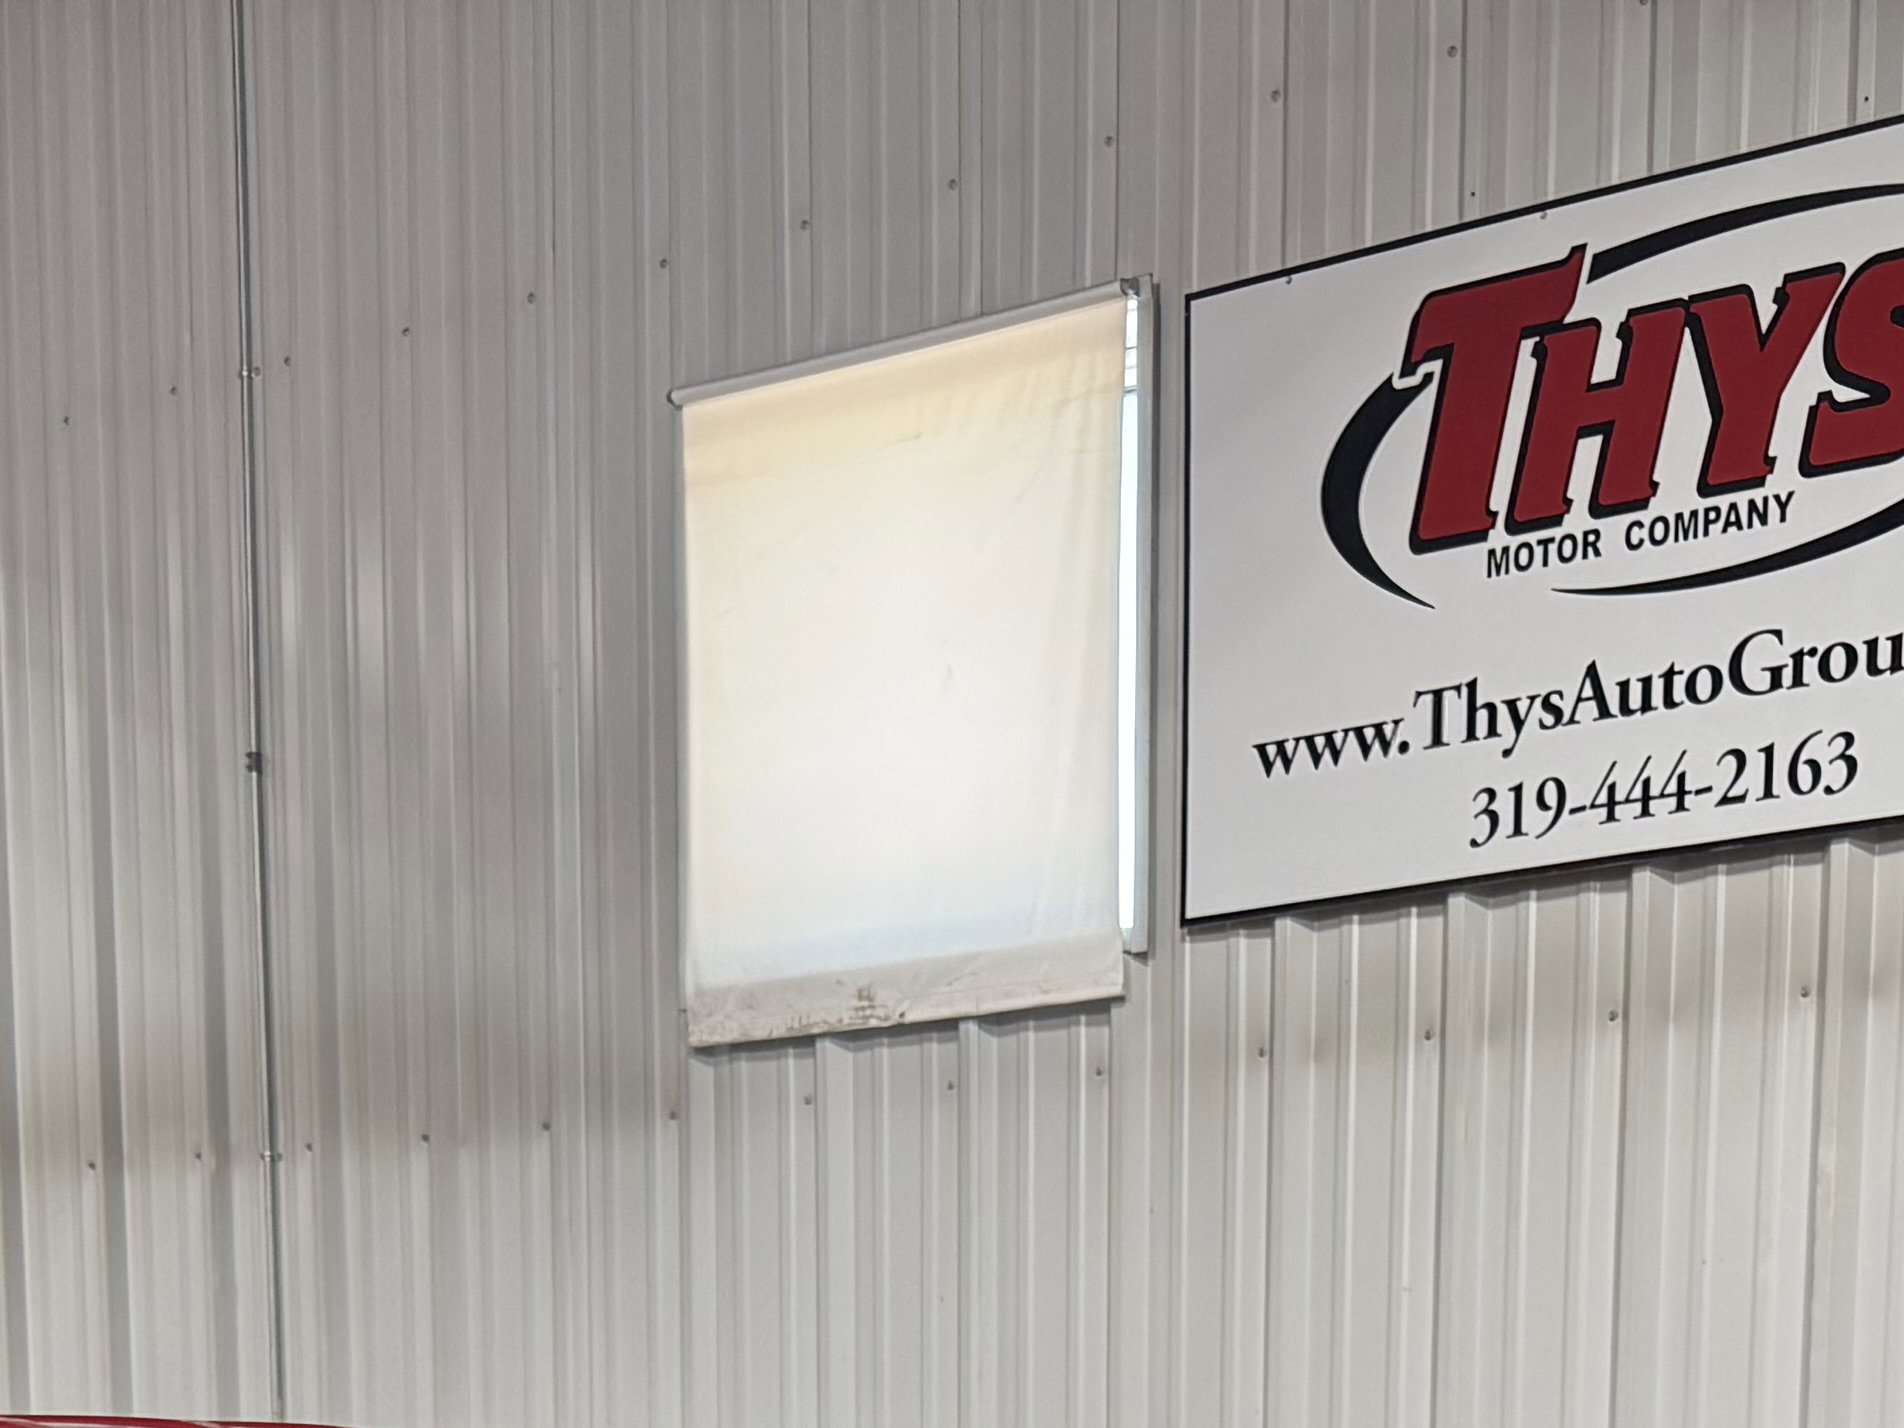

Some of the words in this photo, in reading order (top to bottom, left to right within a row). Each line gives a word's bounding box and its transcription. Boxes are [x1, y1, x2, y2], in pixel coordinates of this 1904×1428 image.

[1486, 527, 1603, 579] MOTOR
[1624, 490, 1797, 551] COMPANY
[1468, 730, 1860, 848] 319-444-2163
